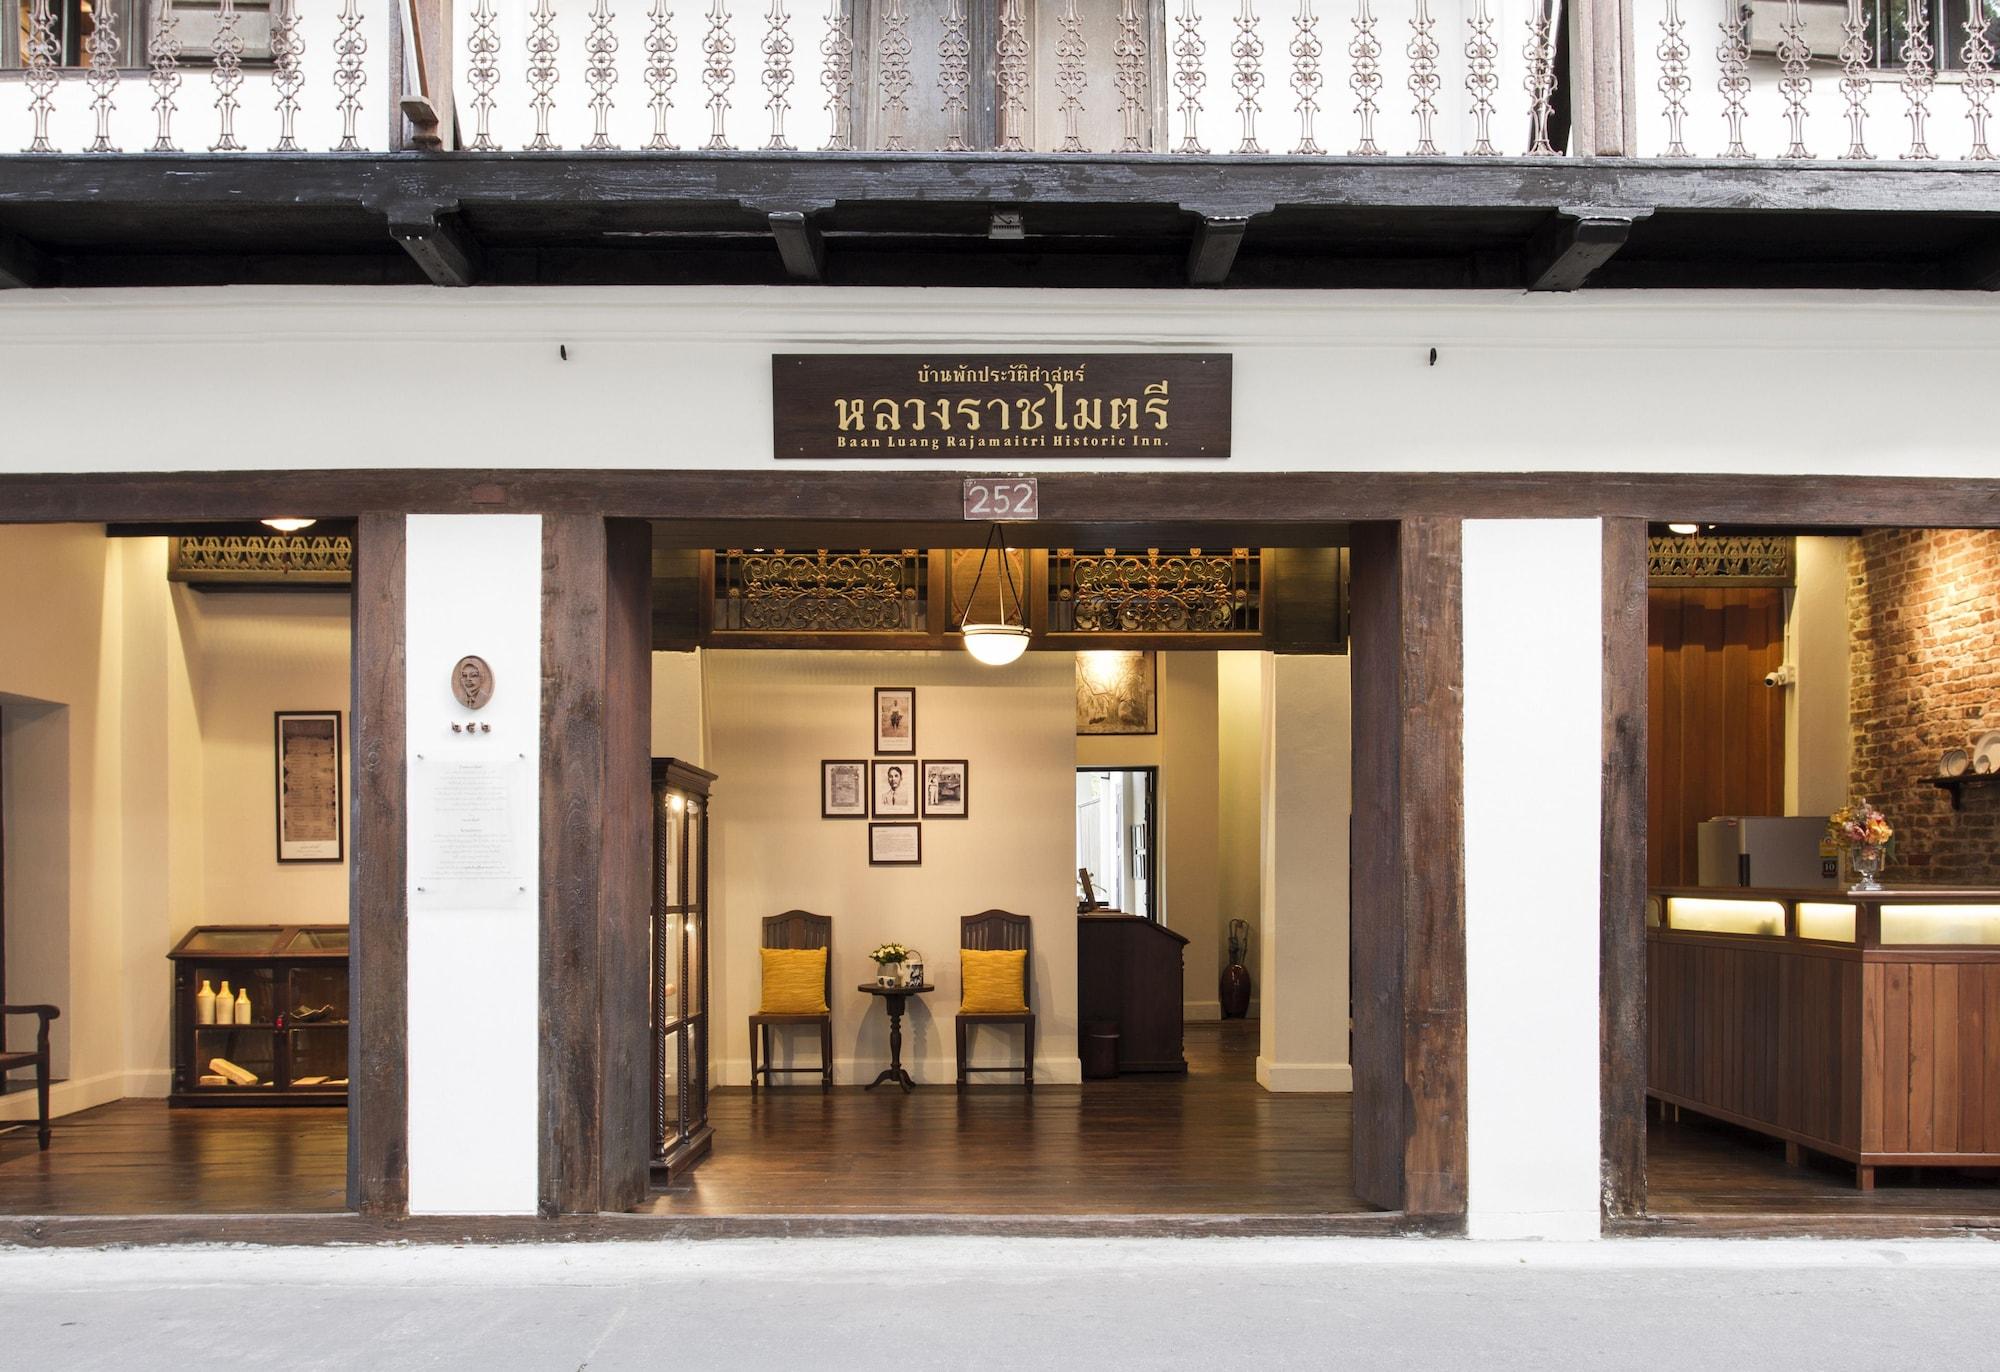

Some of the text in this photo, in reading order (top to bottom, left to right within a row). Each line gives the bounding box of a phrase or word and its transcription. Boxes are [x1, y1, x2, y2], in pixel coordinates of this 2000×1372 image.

[917, 364, 1086, 383] บ้านพักประวัติศาสตร์
[834, 380, 1170, 431] หลวงราชไมตรี
[837, 434, 1169, 450] Baan Luang Rajamaitri Historic Inn.
[969, 483, 1034, 514] 252
